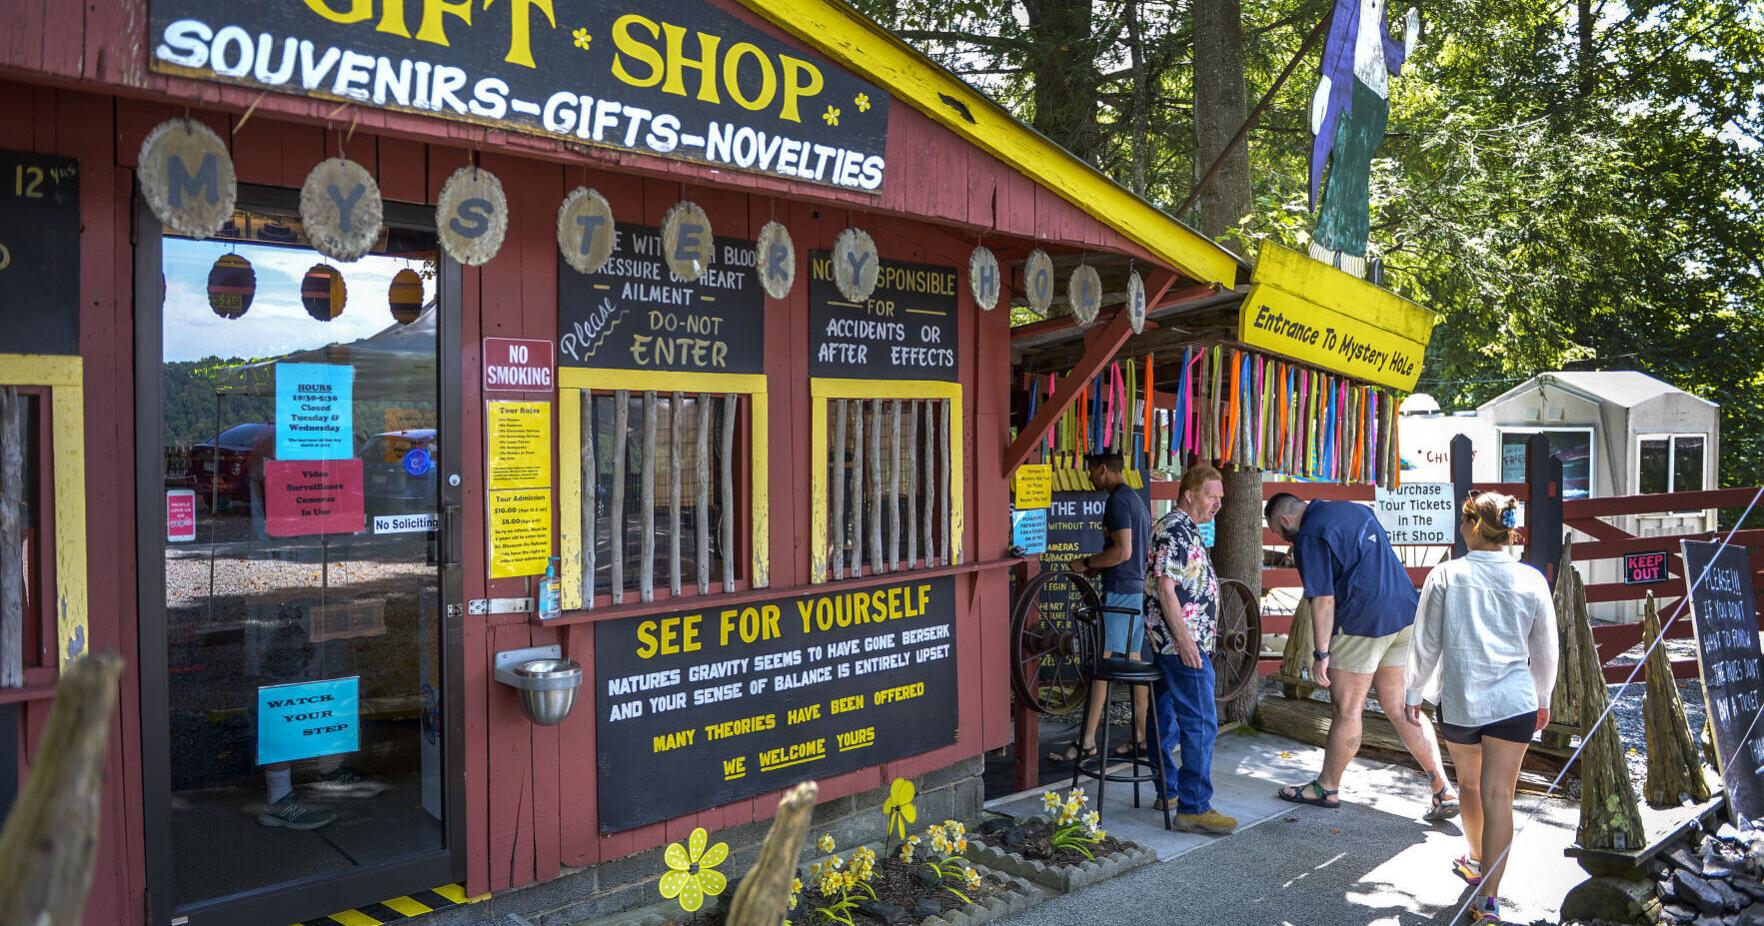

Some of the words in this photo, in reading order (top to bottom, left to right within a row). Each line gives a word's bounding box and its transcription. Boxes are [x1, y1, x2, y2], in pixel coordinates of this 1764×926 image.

[304, 0, 556, 68] FT
[611, 14, 824, 123] SHOP
[15, 164, 44, 198] 12
[633, 233, 663, 257] WIT
[724, 245, 757, 268] BLOO
[598, 257, 661, 280] RESSURE
[699, 269, 745, 290] HEART
[812, 258, 834, 282] NO
[876, 265, 956, 296] SPONSIBLE
[621, 281, 694, 306] AILMENT
[867, 299, 895, 317] FOR
[560, 297, 618, 361] Please
[647, 310, 723, 336] DO-NOT
[826, 318, 905, 341] ACCIDENTS
[920, 325, 941, 344] OR
[1253, 304, 1320, 346] Entrance
[1322, 327, 1337, 351] To
[1338, 333, 1389, 373] Mystery
[509, 344, 528, 364] NO
[630, 333, 728, 368] ENTER
[818, 342, 868, 365] AFTER
[890, 345, 954, 367] EFFECTS
[487, 366, 550, 386] SMOKING
[297, 383, 332, 393] HOURS
[301, 404, 331, 412] Closed
[289, 424, 341, 433] Wednesday
[291, 414, 328, 423] Tuesday
[302, 470, 329, 479] Video
[296, 496, 336, 505] Cameras
[1050, 501, 1076, 516] THE
[1083, 501, 1105, 515] HO
[1379, 500, 1404, 511] Tour
[1410, 499, 1452, 511] Tickets
[376, 519, 389, 530] No
[392, 517, 439, 529] Soliciting
[1048, 521, 1084, 531] WITHOUT
[1089, 521, 1103, 530] TIC
[1413, 515, 1433, 526] The
[1047, 542, 1079, 552] AMERAS
[1628, 555, 1664, 569] KEEP
[1633, 567, 1660, 581] OUT
[636, 614, 702, 659] SEE
[720, 604, 781, 646] FOR
[797, 584, 932, 634] YOURSELF
[608, 669, 681, 696] NATURES
[688, 657, 750, 682] GRAVITY
[754, 650, 802, 671] SEEMS
[808, 645, 822, 662] TO
[827, 639, 860, 659] HAVE
[864, 634, 895, 652] GONE
[902, 623, 950, 646] BERSERK
[609, 700, 643, 722] AND
[649, 692, 687, 714] YOUR
[693, 682, 742, 706] SENSE
[749, 678, 768, 695] OF
[774, 666, 832, 692] BALANCE
[837, 663, 850, 678] IS
[855, 652, 910, 676] ENTIRELY
[916, 644, 950, 664] UPSET
[266, 694, 335, 709] WATCH
[284, 710, 333, 722] YOUR
[653, 729, 696, 753] MANY
[705, 713, 776, 741] THEORIES
[787, 704, 821, 726] HAVE
[831, 694, 864, 715] BEEN
[874, 681, 925, 706] OFFERED
[303, 723, 349, 736] STEP
[723, 755, 746, 776] WE
[759, 737, 826, 768] WELCOME
[836, 726, 875, 749] YOURS
